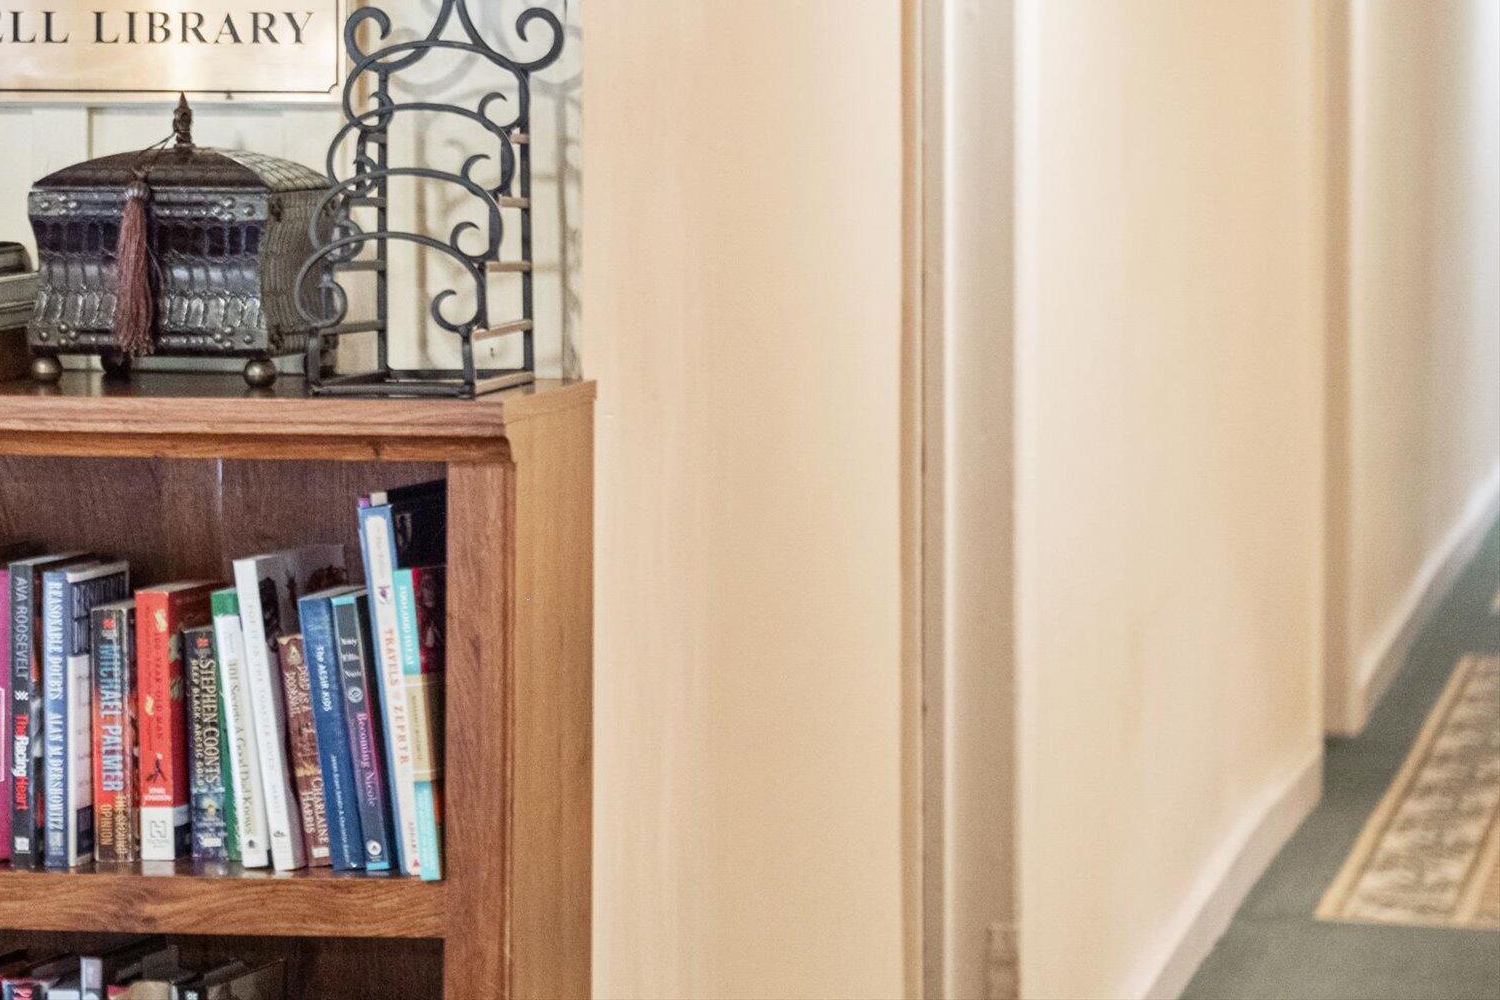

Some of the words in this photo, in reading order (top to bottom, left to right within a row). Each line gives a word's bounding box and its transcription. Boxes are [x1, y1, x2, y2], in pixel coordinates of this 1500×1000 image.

[92, 10, 314, 45] LIBRARY
[14, 577, 27, 601] AVA
[47, 582, 62, 653] REASONABLE
[15, 606, 29, 679] ROOSEVELT
[48, 656, 63, 700] DOUBTS
[99, 644, 121, 718] MICHAEL
[199, 659, 217, 722] STEPHEN
[102, 724, 123, 792] PALMER
[354, 712, 370, 768] Becoming
[364, 772, 377, 807] Nicole
[100, 804, 112, 846] OPINION
[301, 790, 315, 835] HARRIS
[310, 775, 328, 844] CHARLAINE
